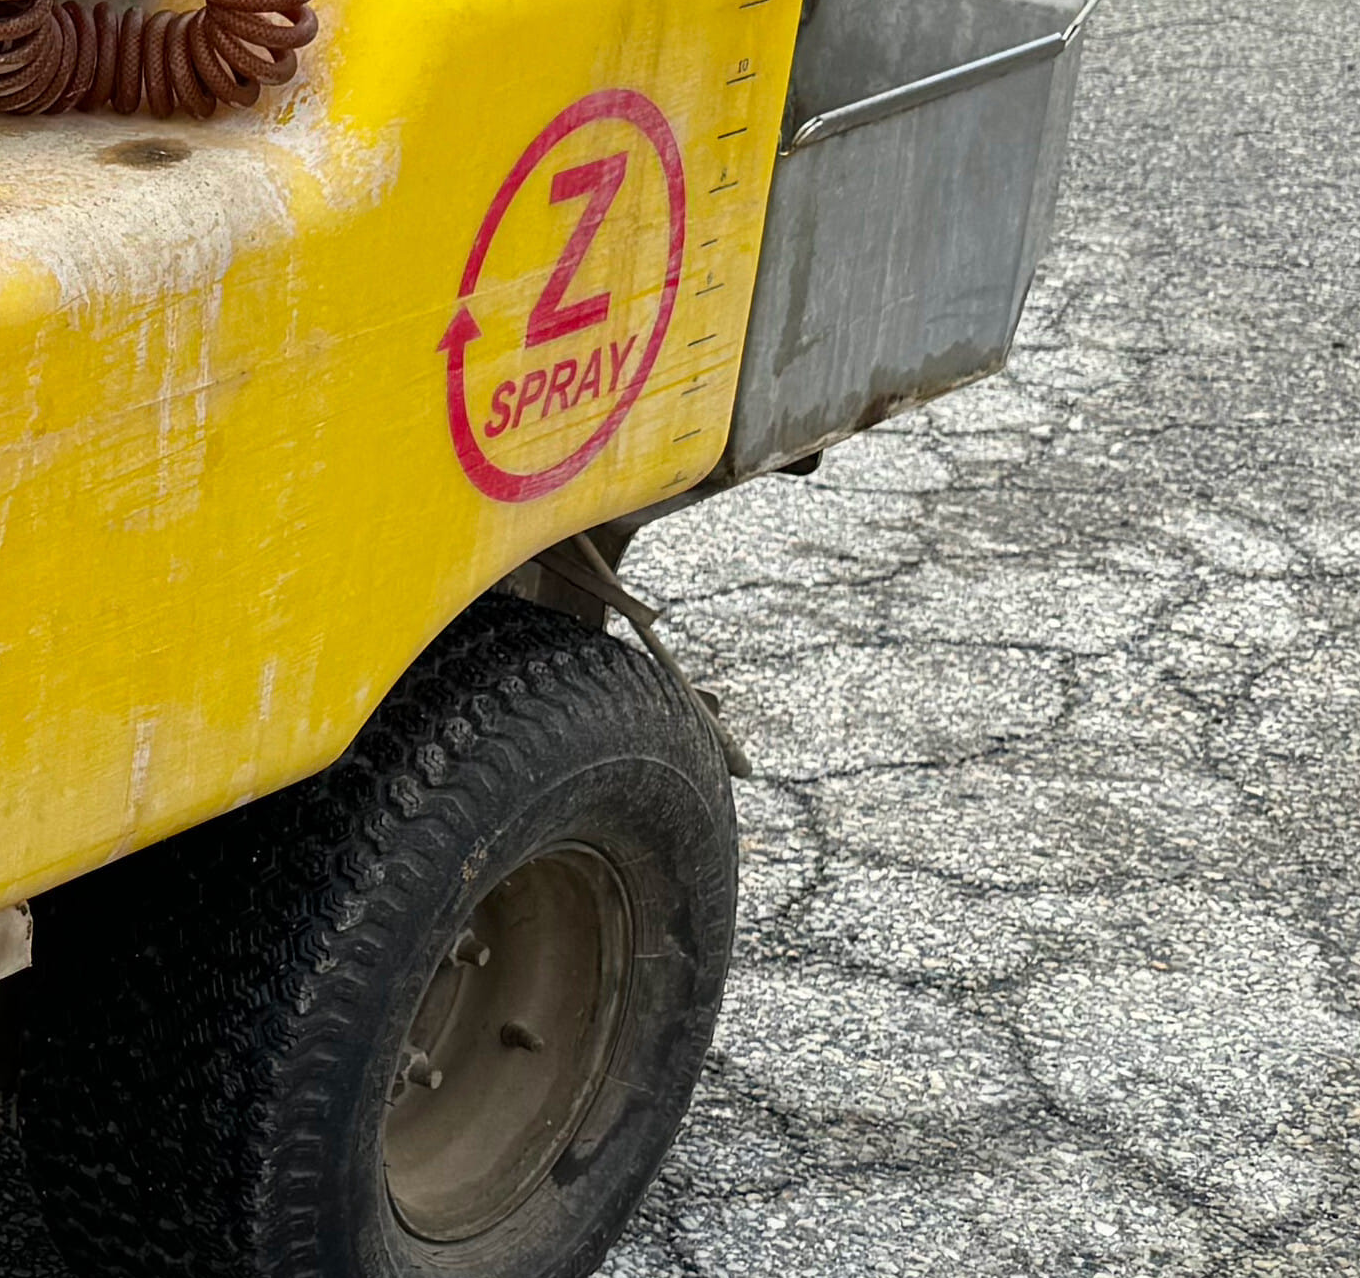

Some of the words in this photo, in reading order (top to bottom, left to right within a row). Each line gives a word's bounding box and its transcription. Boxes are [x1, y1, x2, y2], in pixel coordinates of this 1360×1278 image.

[738, 58, 749, 73] 10
[525, 150, 629, 350] Z
[484, 333, 639, 439] SPRAY
